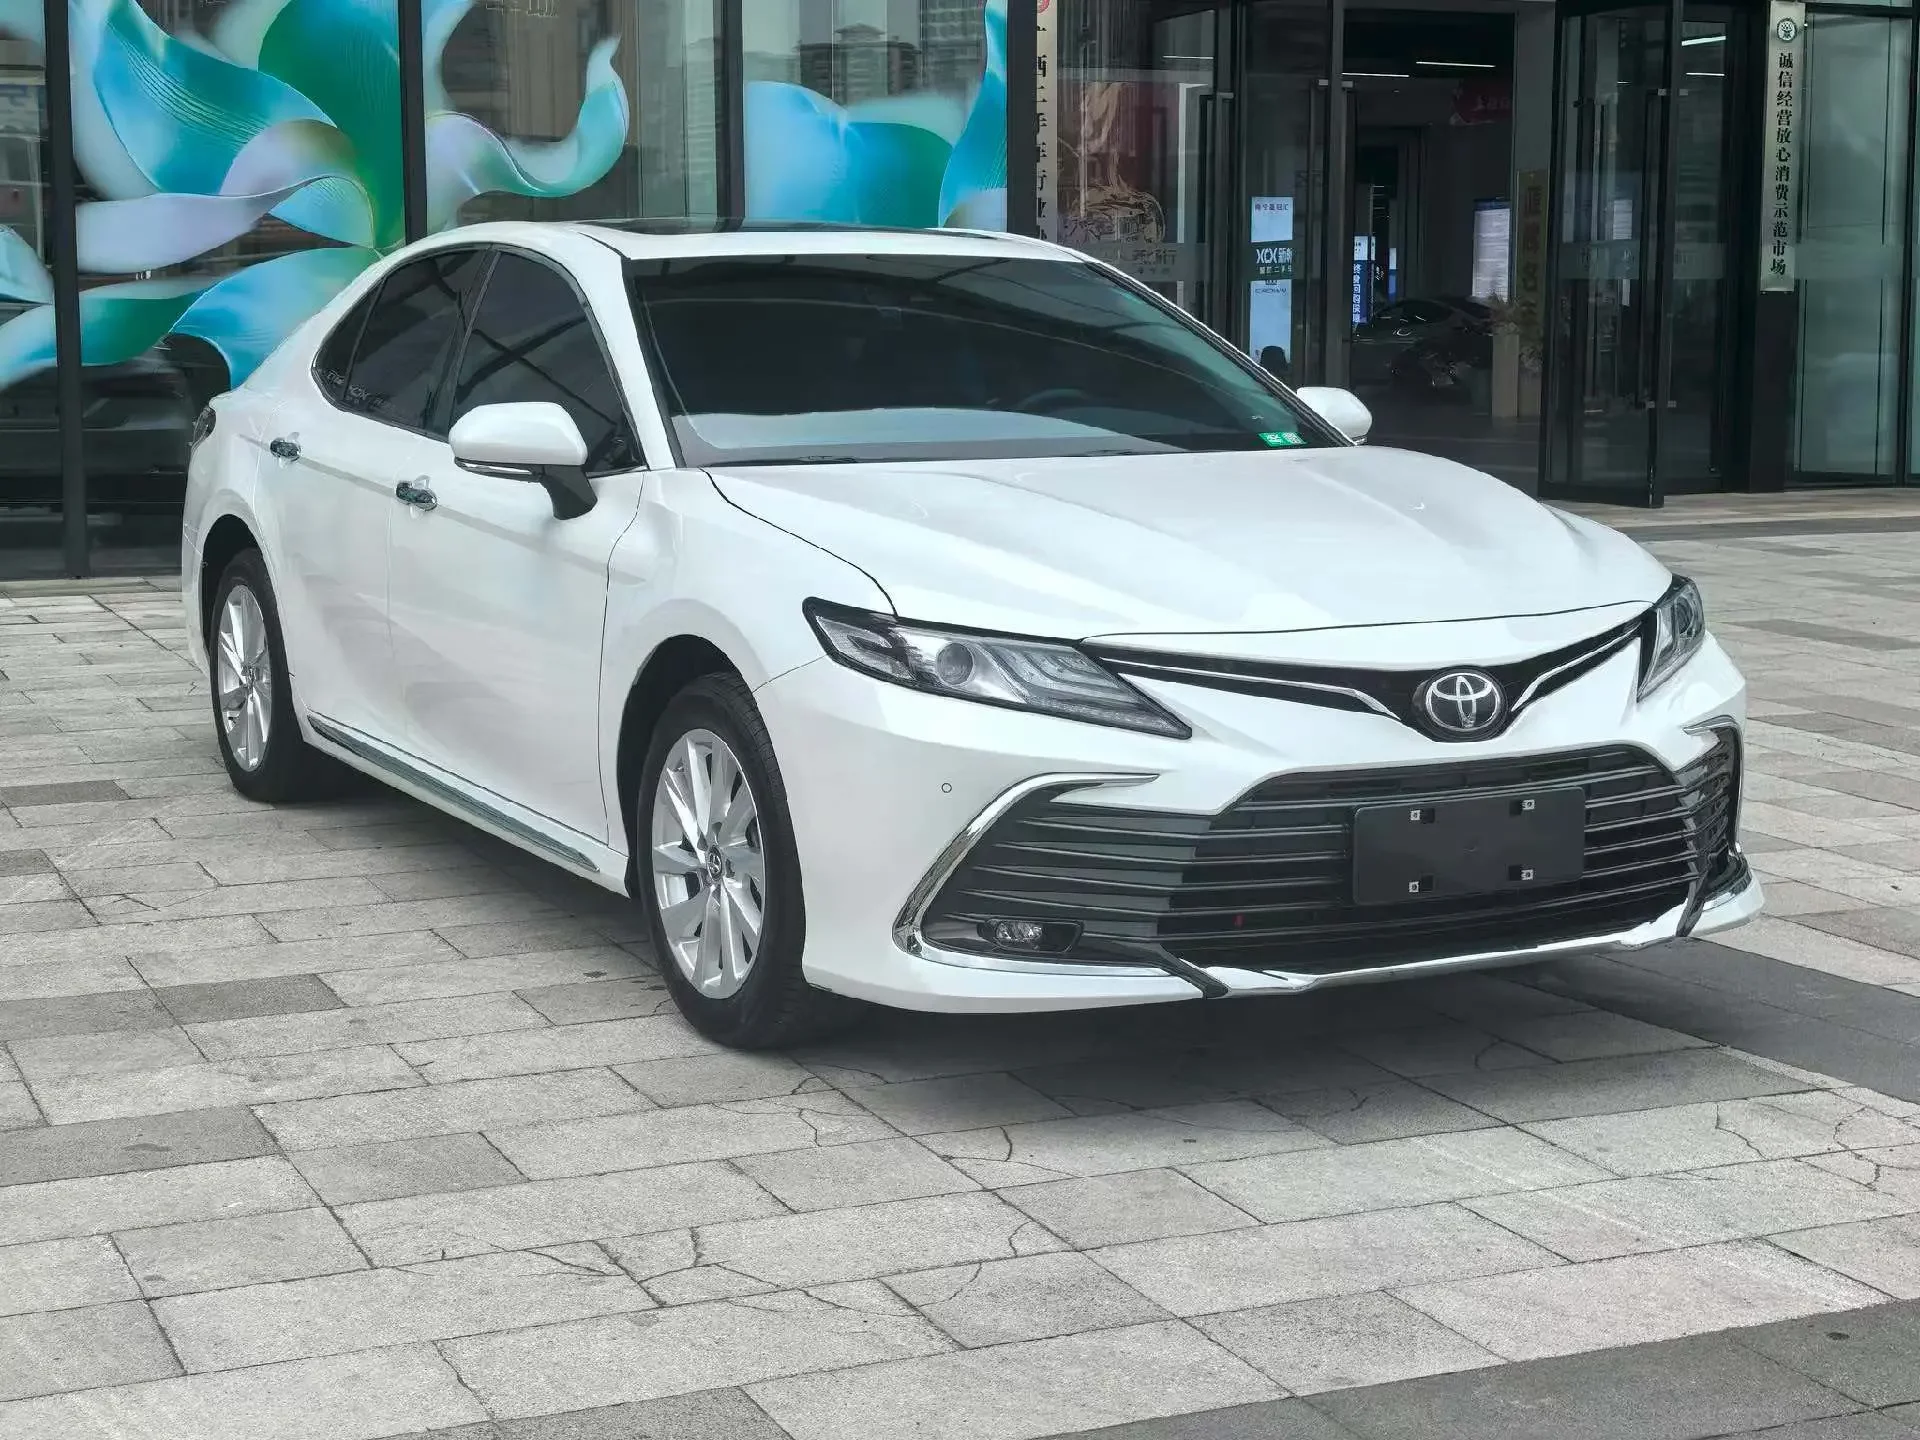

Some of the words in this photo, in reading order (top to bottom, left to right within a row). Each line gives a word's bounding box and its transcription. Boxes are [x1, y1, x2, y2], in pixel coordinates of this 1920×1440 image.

[1771, 52, 1793, 276] 诚信经营放心消费示范市场
